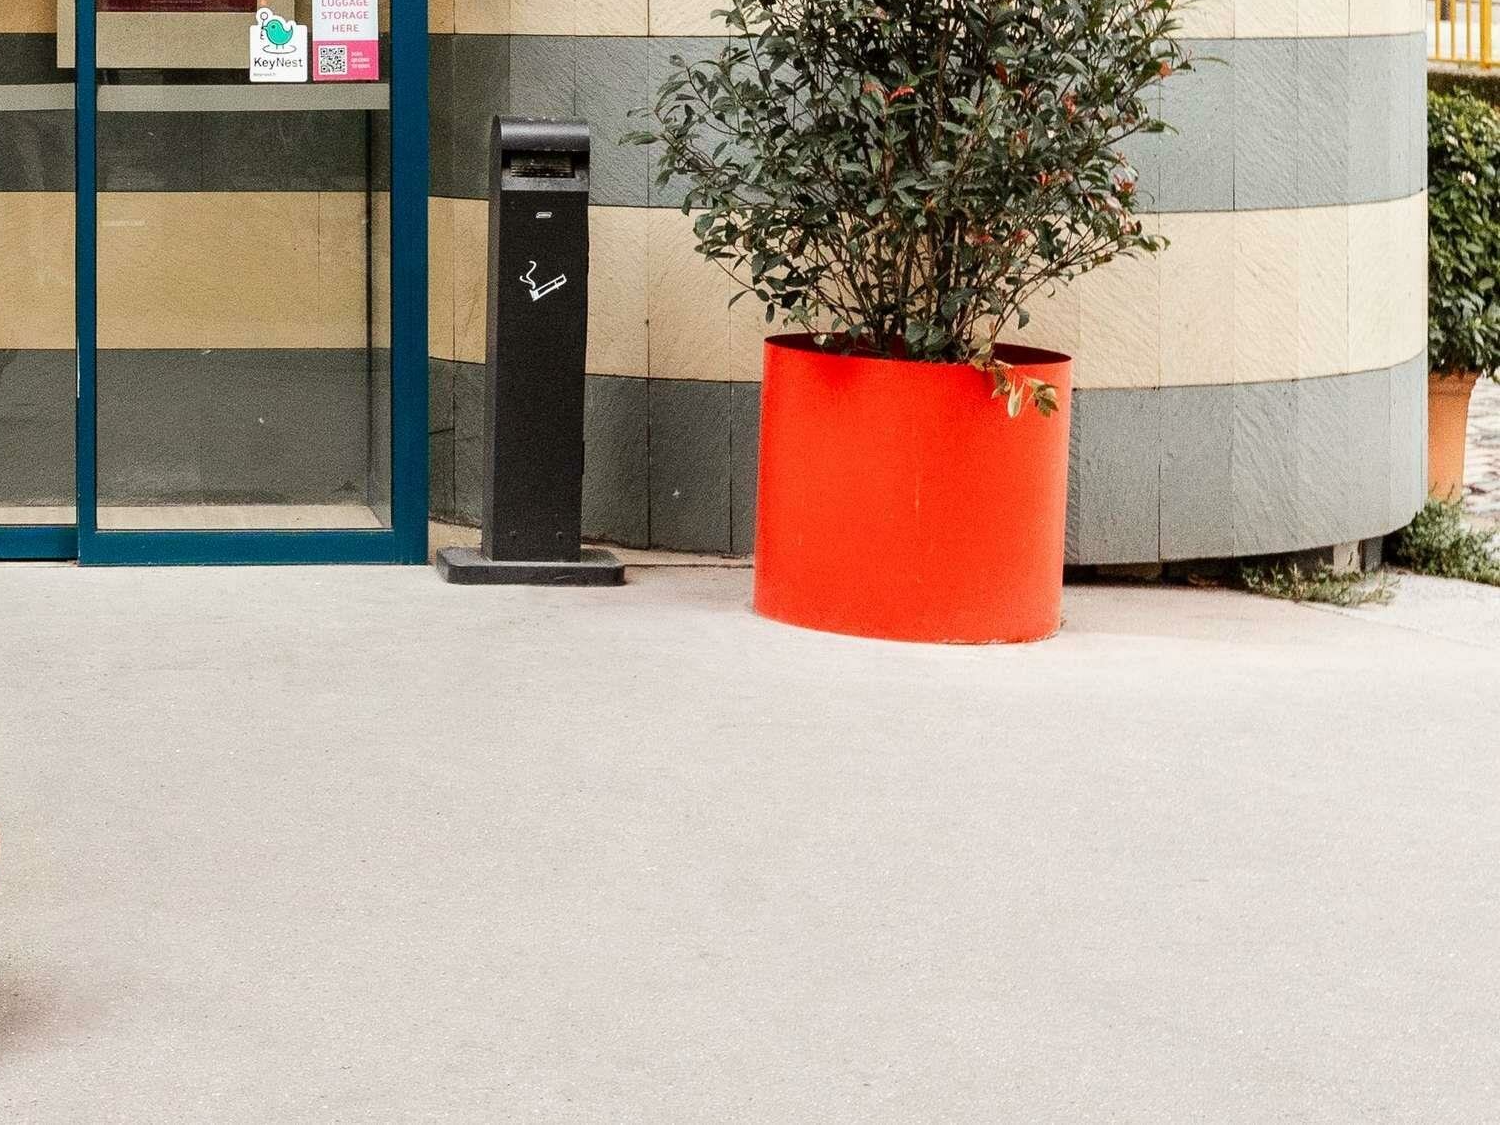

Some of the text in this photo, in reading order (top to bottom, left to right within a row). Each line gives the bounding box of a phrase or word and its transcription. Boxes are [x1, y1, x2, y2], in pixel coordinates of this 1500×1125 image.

[321, 10, 369, 20] STORAGE
[332, 24, 360, 33] HERE
[253, 57, 303, 70] KeyNest
